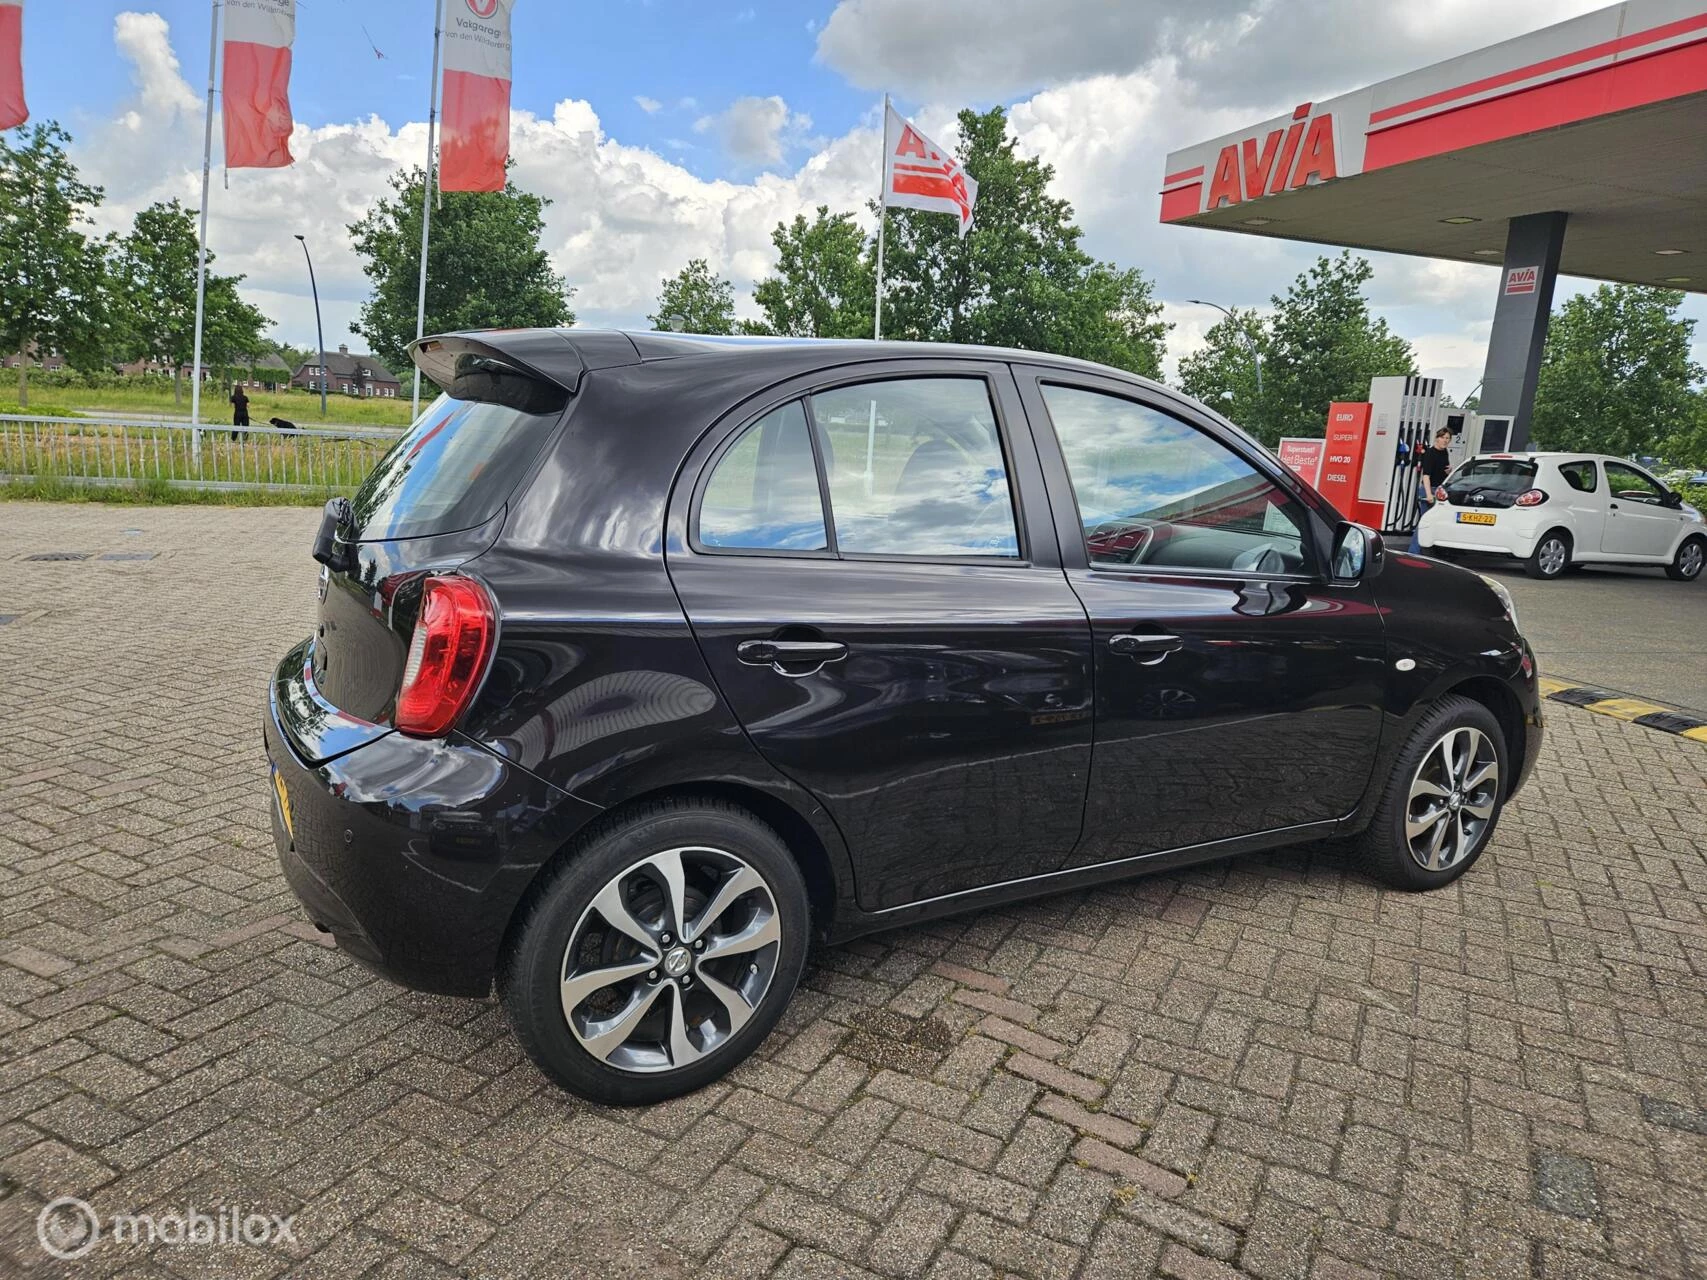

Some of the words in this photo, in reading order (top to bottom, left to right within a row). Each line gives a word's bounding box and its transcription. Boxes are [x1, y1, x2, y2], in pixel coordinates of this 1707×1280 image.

[456, 17, 502, 39] Vakgarag
[1336, 413, 1354, 422] EURO
[1333, 433, 1353, 442] SUPER
[1455, 435, 1461, 444] 2
[1329, 455, 1343, 463] HVO
[1343, 456, 1351, 464] 20
[1327, 473, 1347, 482] DIESEL
